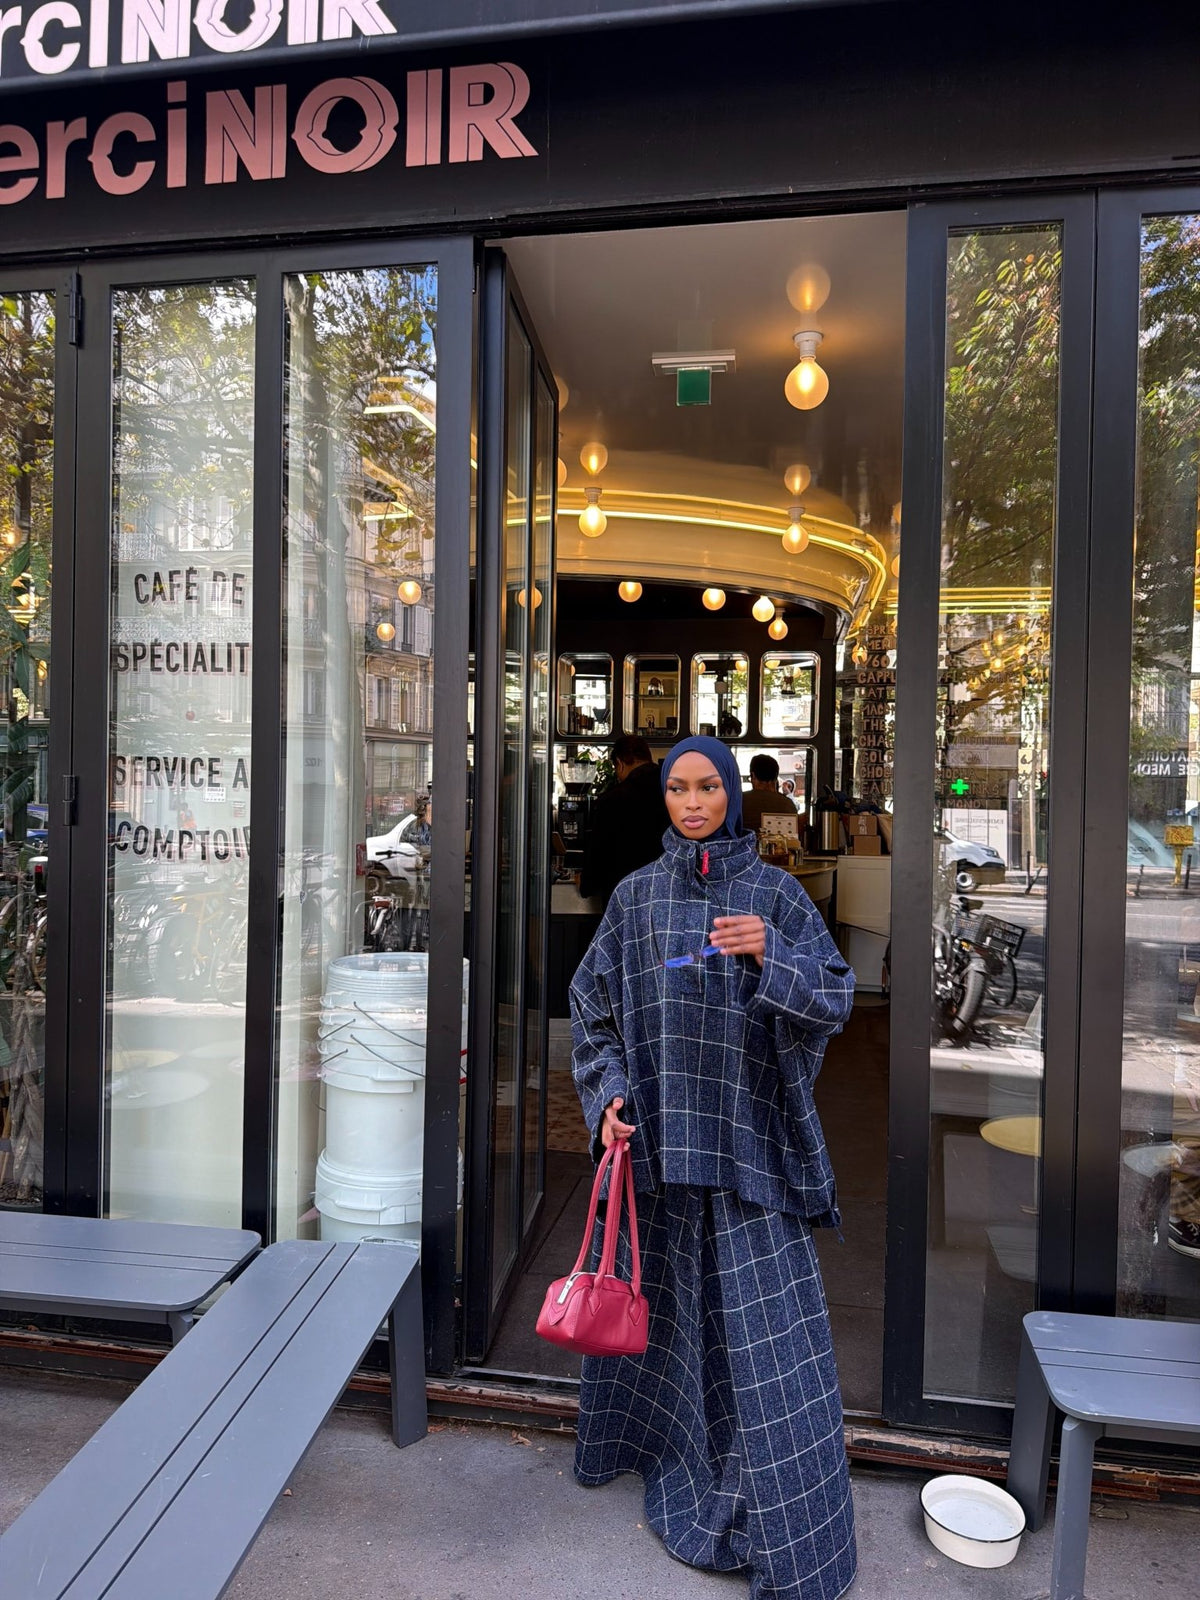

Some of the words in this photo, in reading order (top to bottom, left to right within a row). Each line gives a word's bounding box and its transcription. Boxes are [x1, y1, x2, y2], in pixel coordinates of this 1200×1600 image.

[121, 0, 397, 64] NOIR
[204, 62, 539, 184] NOIR
[134, 567, 200, 605] CAFÉ
[212, 571, 246, 605] DE
[115, 755, 222, 789] SERVICE
